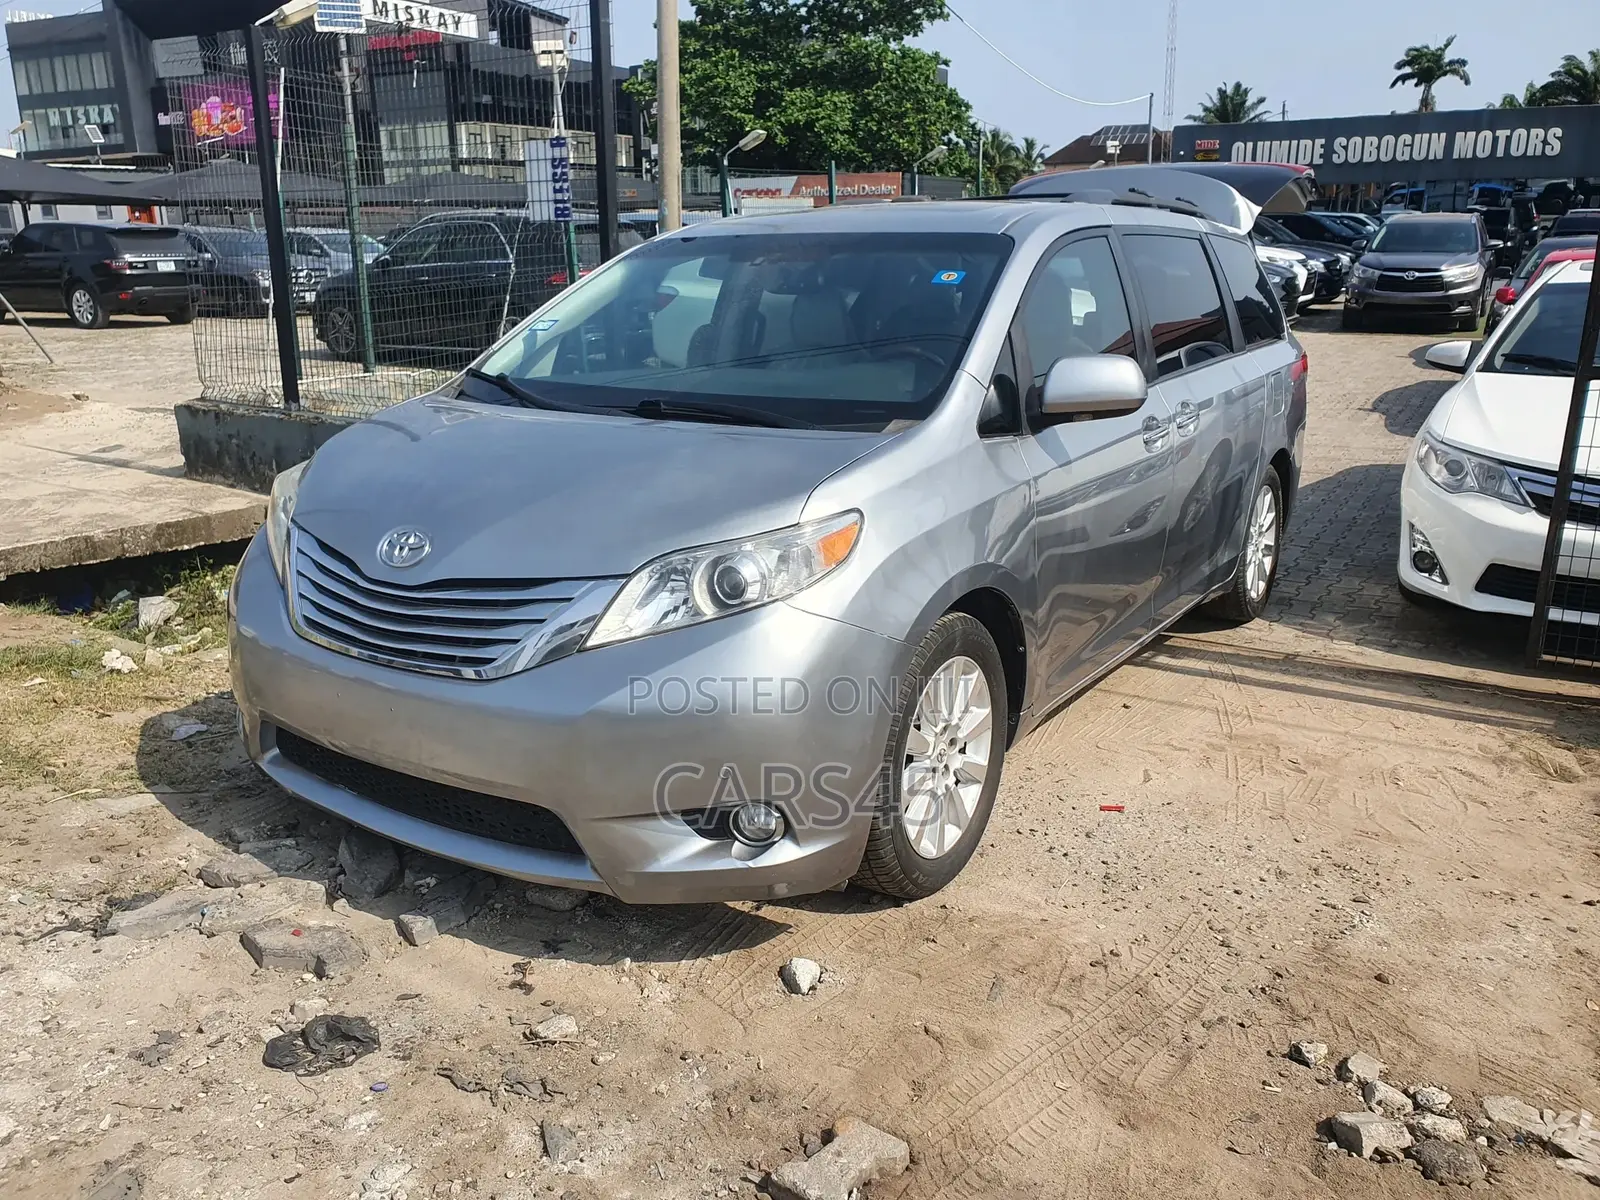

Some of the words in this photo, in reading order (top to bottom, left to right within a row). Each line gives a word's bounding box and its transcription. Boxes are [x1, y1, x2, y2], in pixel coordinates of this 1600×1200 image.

[371, 0, 461, 31] MISKAY
[1231, 138, 1326, 165] OLUMIDE
[1332, 133, 1447, 164] SOBOGUN
[1452, 127, 1563, 159] MOTORS
[799, 184, 858, 197] Authoized
[859, 183, 897, 196] Dealer
